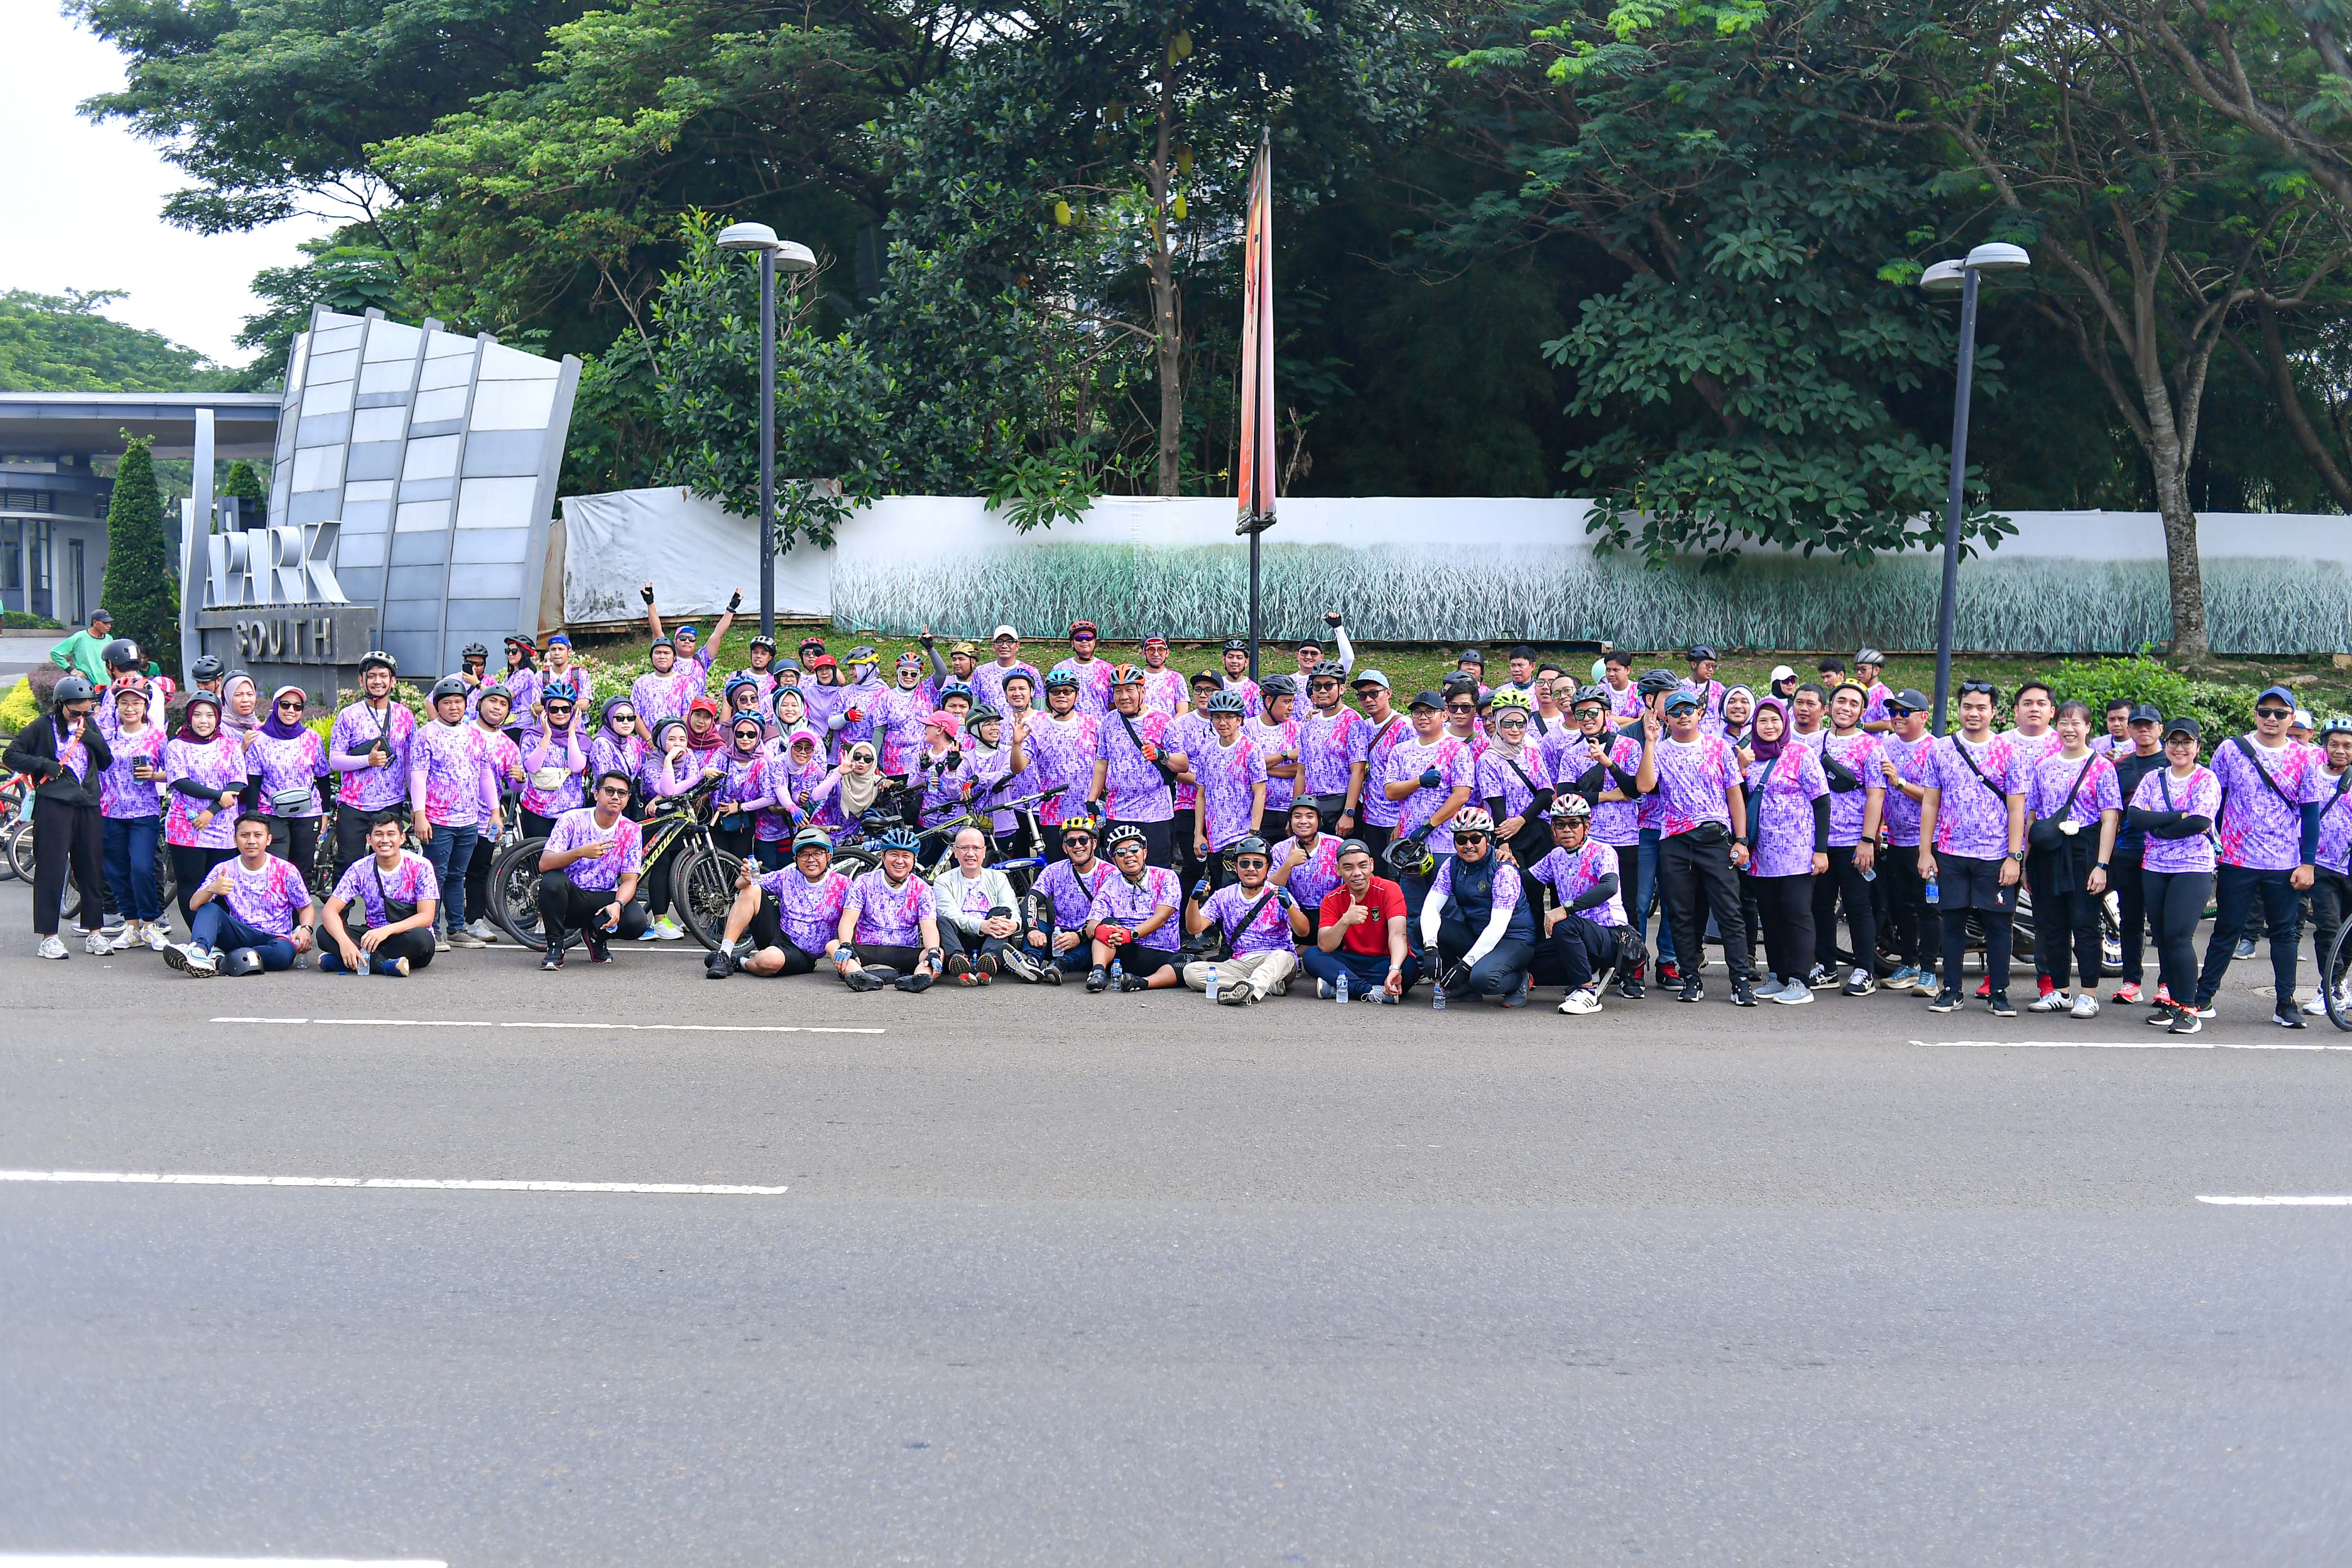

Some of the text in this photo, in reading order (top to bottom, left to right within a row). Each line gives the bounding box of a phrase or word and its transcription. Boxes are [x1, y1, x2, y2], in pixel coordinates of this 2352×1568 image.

[235, 617, 332, 657] SOUTH
[640, 831, 672, 875] EXOTIC
[934, 847, 952, 874] EXO
